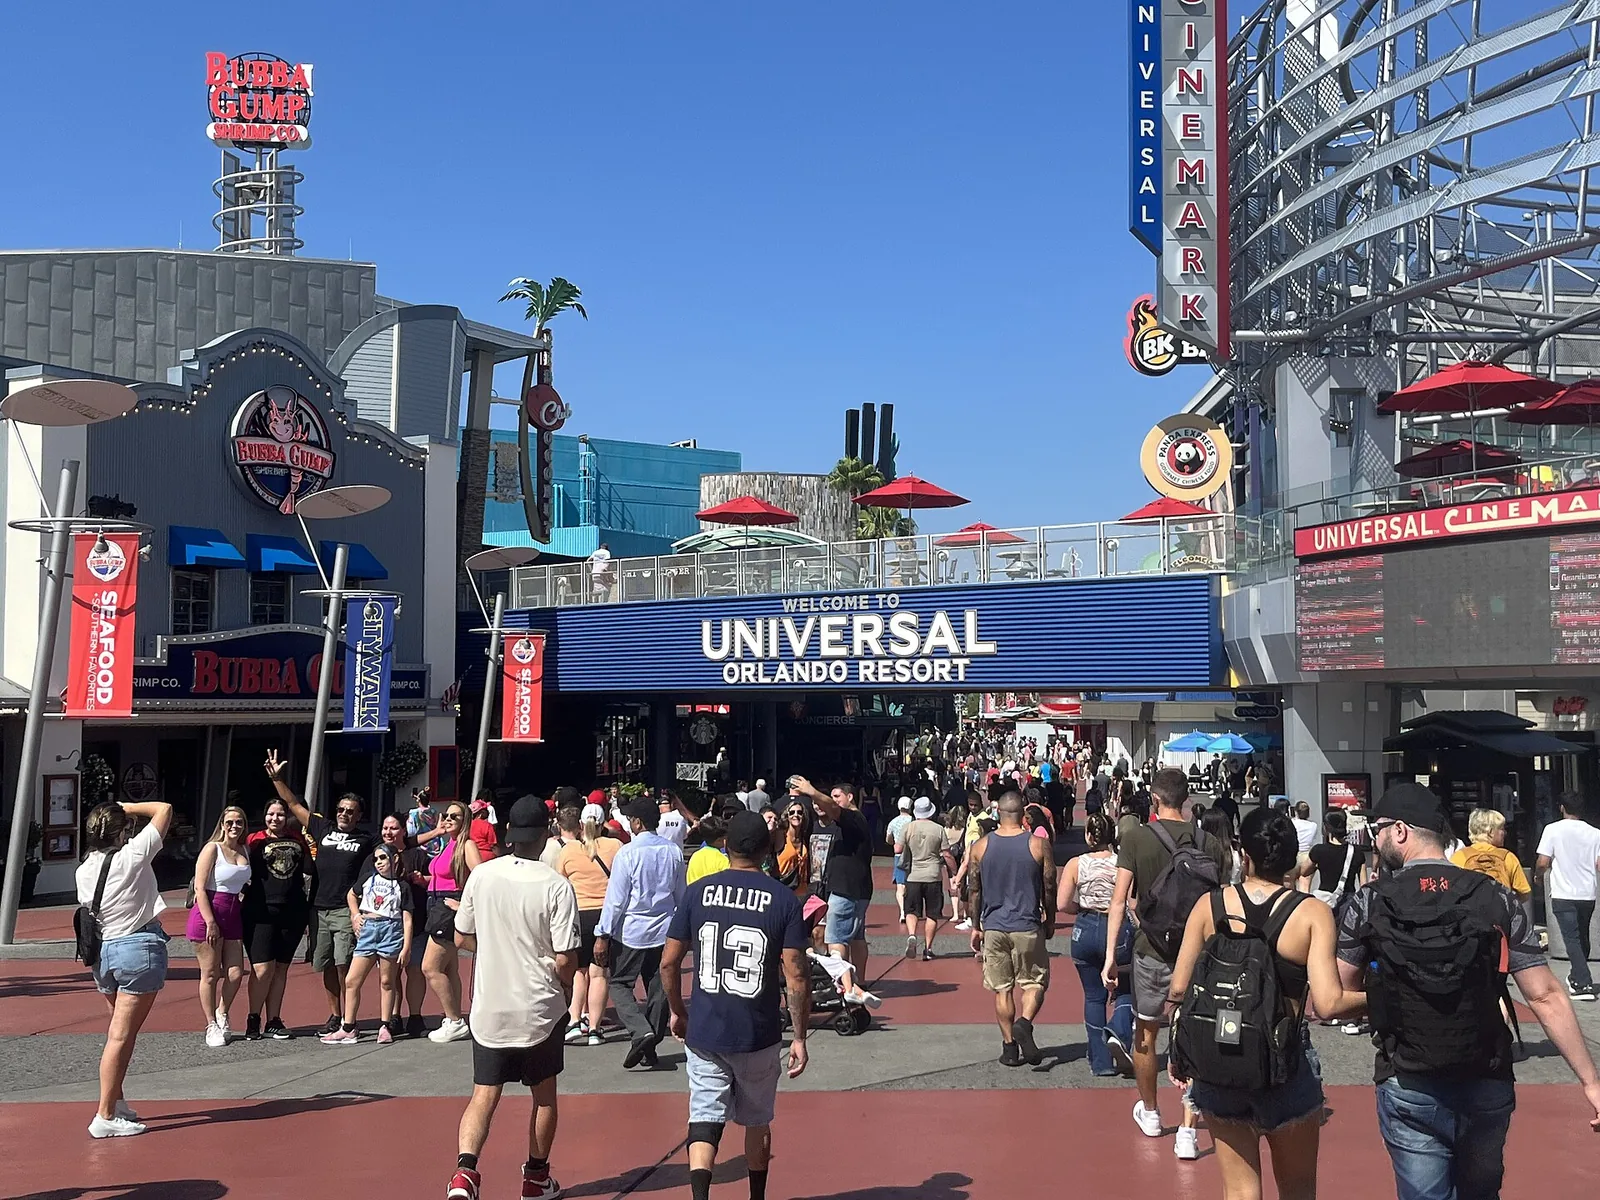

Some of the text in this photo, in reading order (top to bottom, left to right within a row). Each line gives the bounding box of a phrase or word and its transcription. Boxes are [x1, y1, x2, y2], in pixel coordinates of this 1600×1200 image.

[205, 51, 310, 89] BUBBA
[210, 85, 305, 120] GUMP
[213, 123, 275, 140] SHRIMP
[1176, 0, 1206, 320] INEMARK
[1142, 333, 1175, 361] BK
[540, 401, 573, 426] Club
[237, 440, 331, 474] BUBBA GUMP
[1159, 429, 1216, 458] PANDA EXPRESS
[1159, 461, 1215, 485] GOURMET CHINESE FOOD
[1314, 496, 1600, 551] UNIVERSAL CINEMA
[1169, 555, 1209, 569] ELCOME
[782, 593, 901, 613] WELCOME TO
[96, 590, 118, 705] SEAFOOD
[701, 608, 998, 661] UNIVERSAL
[190, 650, 301, 695] BUBBA
[359, 600, 384, 731] CITYWALK
[722, 657, 971, 684] ORLANDO RESORT
[86, 656, 97, 712] FAVORITES
[161, 677, 181, 688] CO.
[520, 667, 532, 735] SEAFOOD
[795, 715, 856, 725] CONCIERGE
[1327, 782, 1346, 790] FREE
[1327, 788, 1355, 797] PARKIN
[328, 831, 350, 842] JUST
[702, 884, 772, 913] GALLUP
[698, 921, 768, 999] 13
